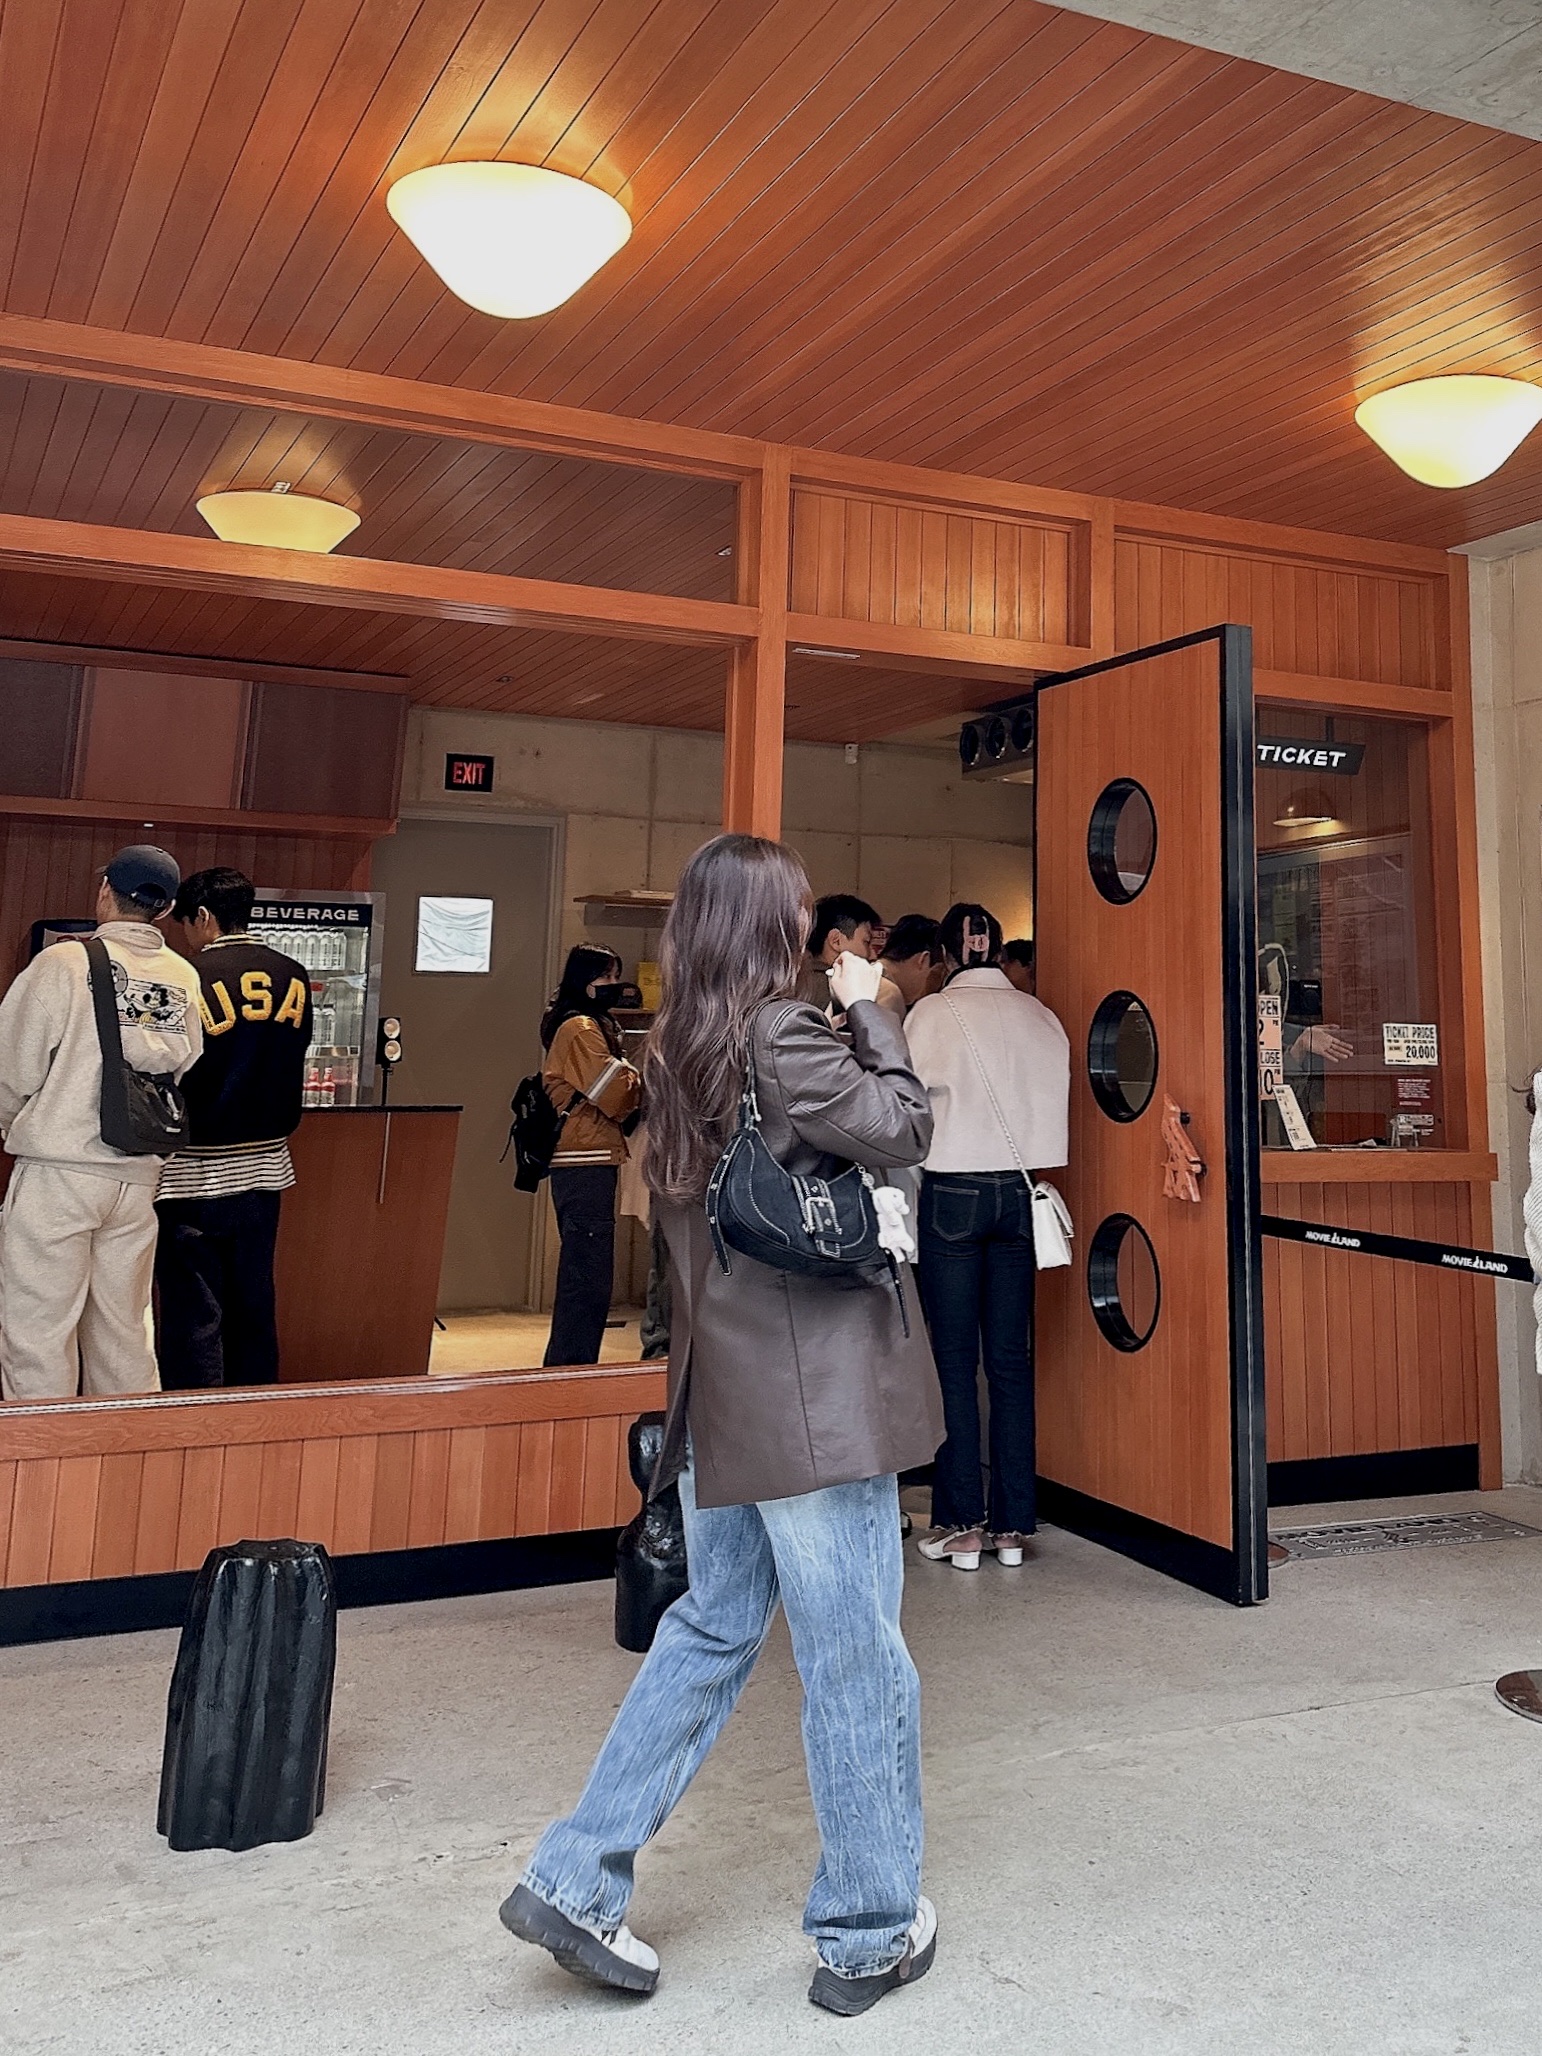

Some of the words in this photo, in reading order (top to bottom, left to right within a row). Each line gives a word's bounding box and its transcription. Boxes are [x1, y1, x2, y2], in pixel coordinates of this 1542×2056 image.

[1257, 744, 1347, 768] TICKET
[452, 761, 486, 785] EXIT
[249, 905, 360, 922] BEVERAGE
[198, 971, 306, 1036] USA
[1258, 1000, 1279, 1015] PEN
[1385, 1025, 1409, 1038] TICKET
[1411, 1026, 1435, 1039] PRICE
[1259, 1051, 1281, 1064] LOSE
[1405, 1045, 1436, 1059] 20,000
